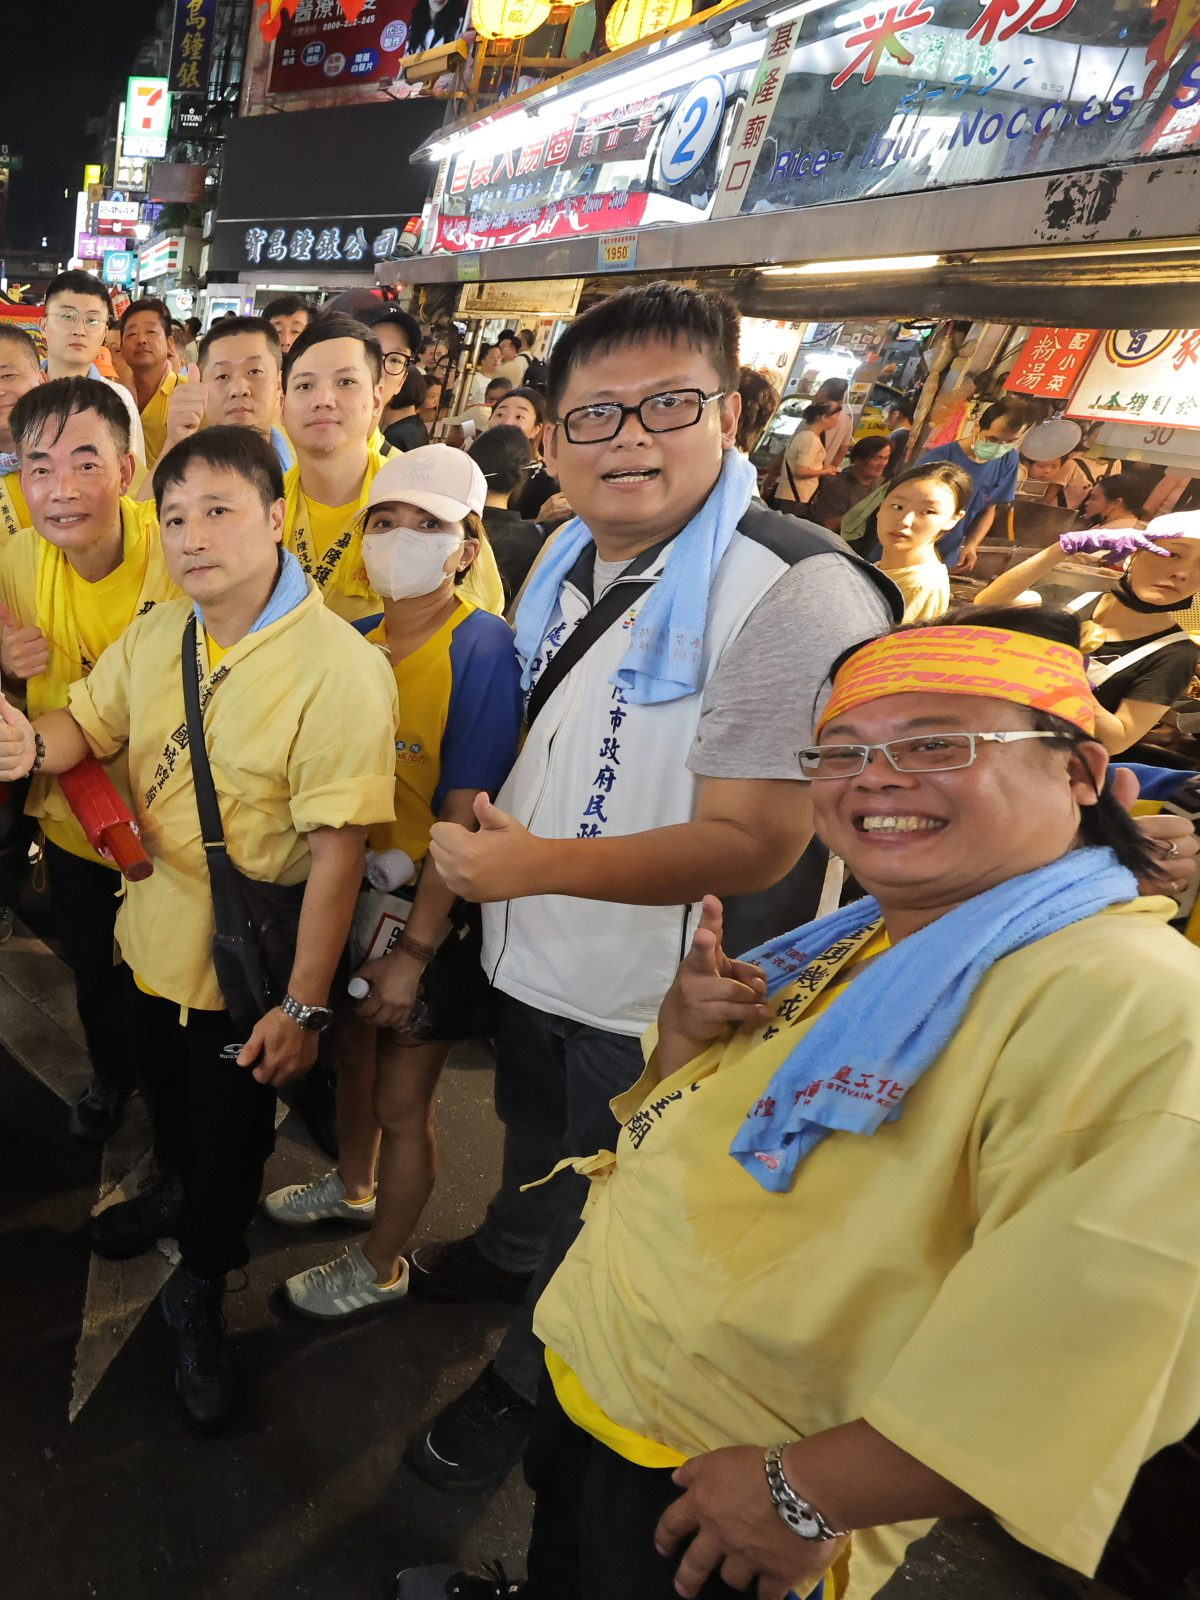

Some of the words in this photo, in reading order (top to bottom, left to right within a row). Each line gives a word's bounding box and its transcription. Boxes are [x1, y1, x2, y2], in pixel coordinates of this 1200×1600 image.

[180, 113, 203, 122] TITONI
[670, 95, 709, 165] 2
[606, 245, 628, 260] 1950
[1016, 327, 1067, 391] 粉湯
[1045, 332, 1091, 392] 配小菜
